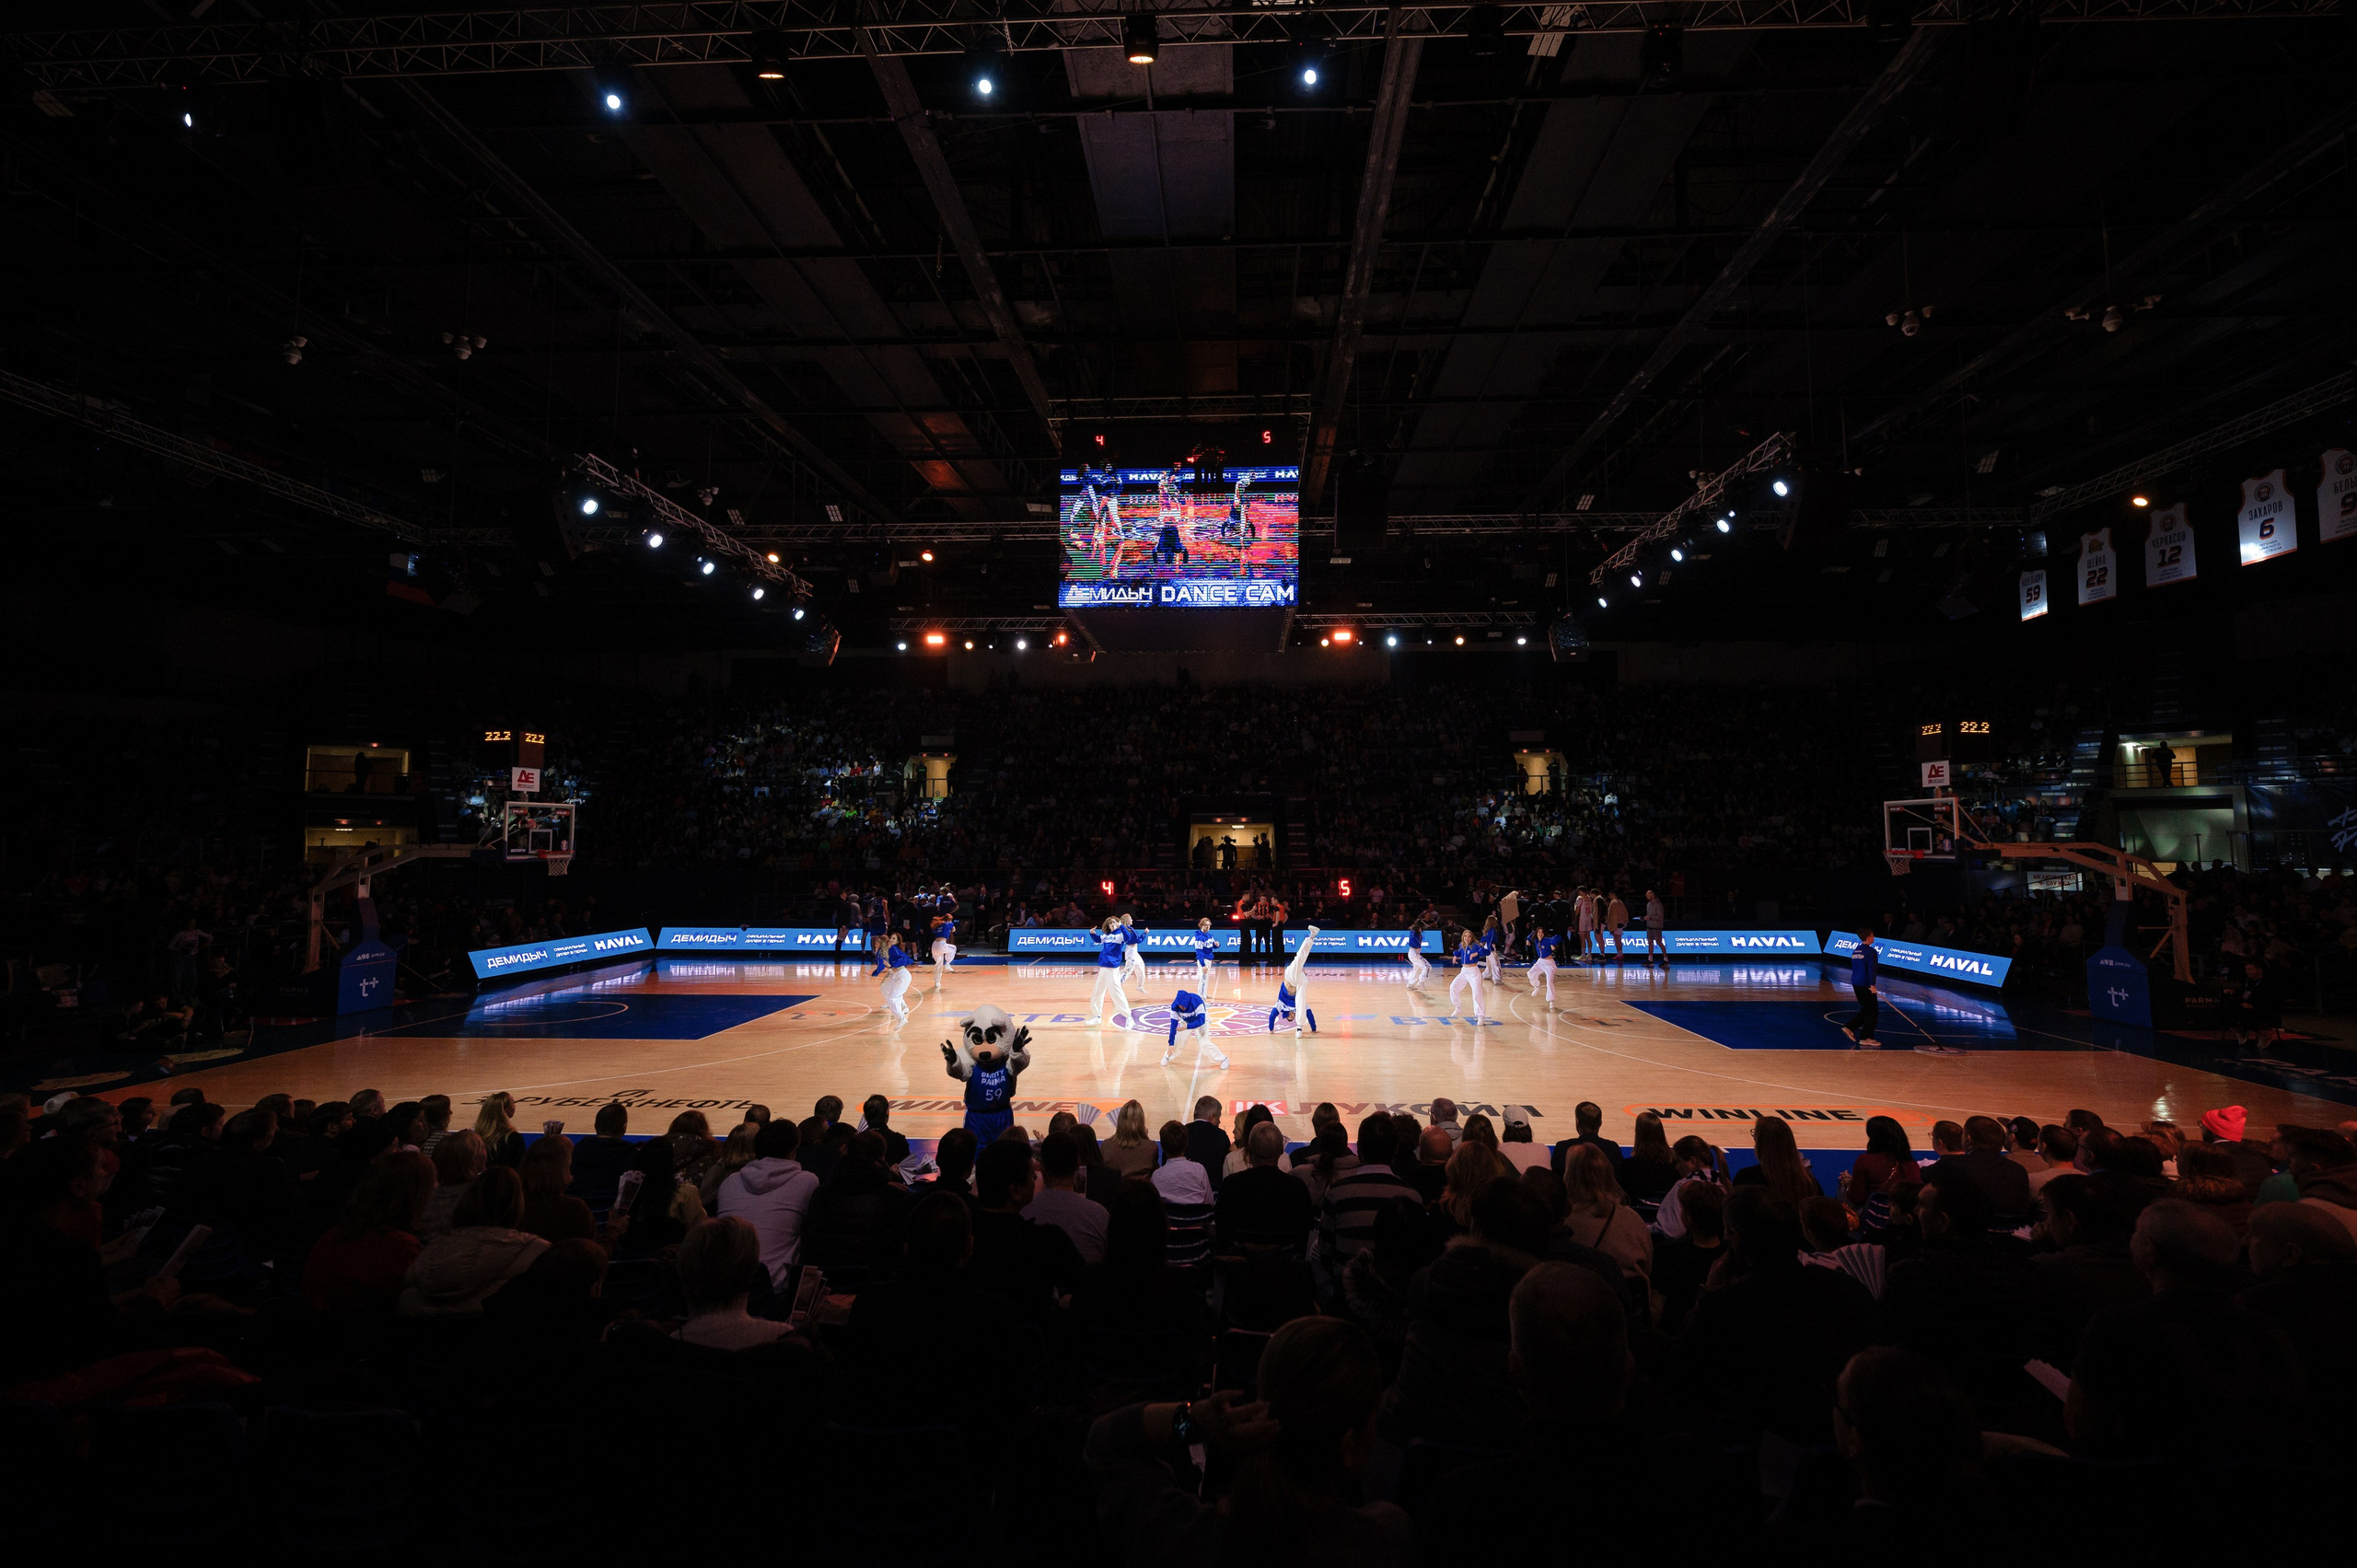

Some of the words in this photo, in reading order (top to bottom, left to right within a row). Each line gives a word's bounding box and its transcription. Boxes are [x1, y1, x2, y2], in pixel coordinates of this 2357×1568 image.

[1096, 436, 1104, 446] 4
[1262, 431, 1271, 443] 5
[2248, 500, 2283, 521] ЗАХАРОВ
[2258, 517, 2275, 540] 6
[2157, 545, 2182, 568] 12
[2085, 566, 2108, 589] 22
[1161, 586, 1238, 602] DANCE
[1246, 585, 1295, 601] CAM
[2026, 585, 2040, 604] 59
[1960, 722, 1990, 733] 22.2
[485, 731, 511, 741] 22.2
[1102, 881, 1112, 895] 4
[1341, 880, 1351, 896] 5
[594, 935, 644, 951] HAVAL
[670, 935, 737, 943] ДЕМИДЫЧ
[1017, 936, 1085, 946] ДЕМИДЫЧ
[1731, 936, 1805, 947] HAVAL
[487, 950, 548, 970] ДЕМИДЫЧ
[1930, 954, 1993, 976] HAVAL
[2184, 996, 2220, 1005] PARMA
[1007, 1014, 1086, 1022] ТБ
[985, 1088, 1003, 1101] 59
[462, 1097, 757, 1109] ЗРУБЕЖНЕФТЬ
